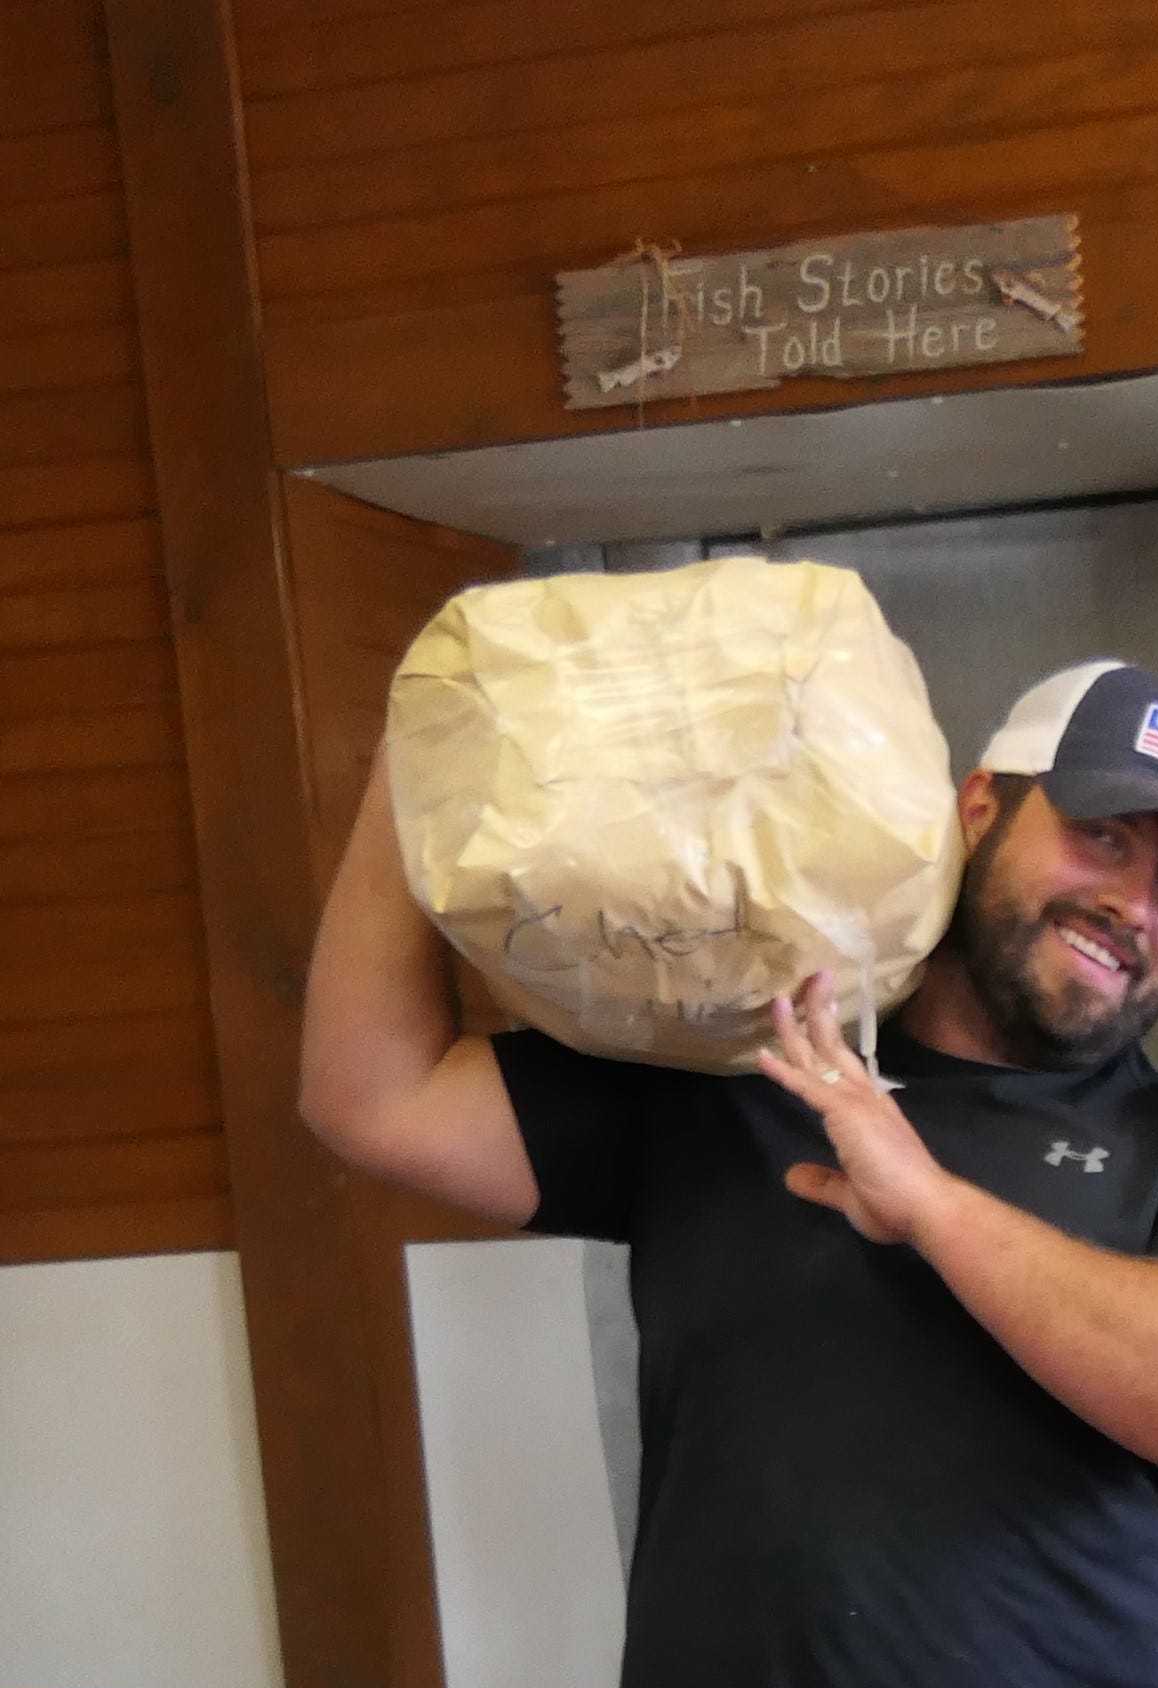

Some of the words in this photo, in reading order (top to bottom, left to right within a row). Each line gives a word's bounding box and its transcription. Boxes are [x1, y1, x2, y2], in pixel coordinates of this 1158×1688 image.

[797, 252, 984, 313] Stories
[742, 317, 844, 377] Told
[880, 301, 998, 364] Here
